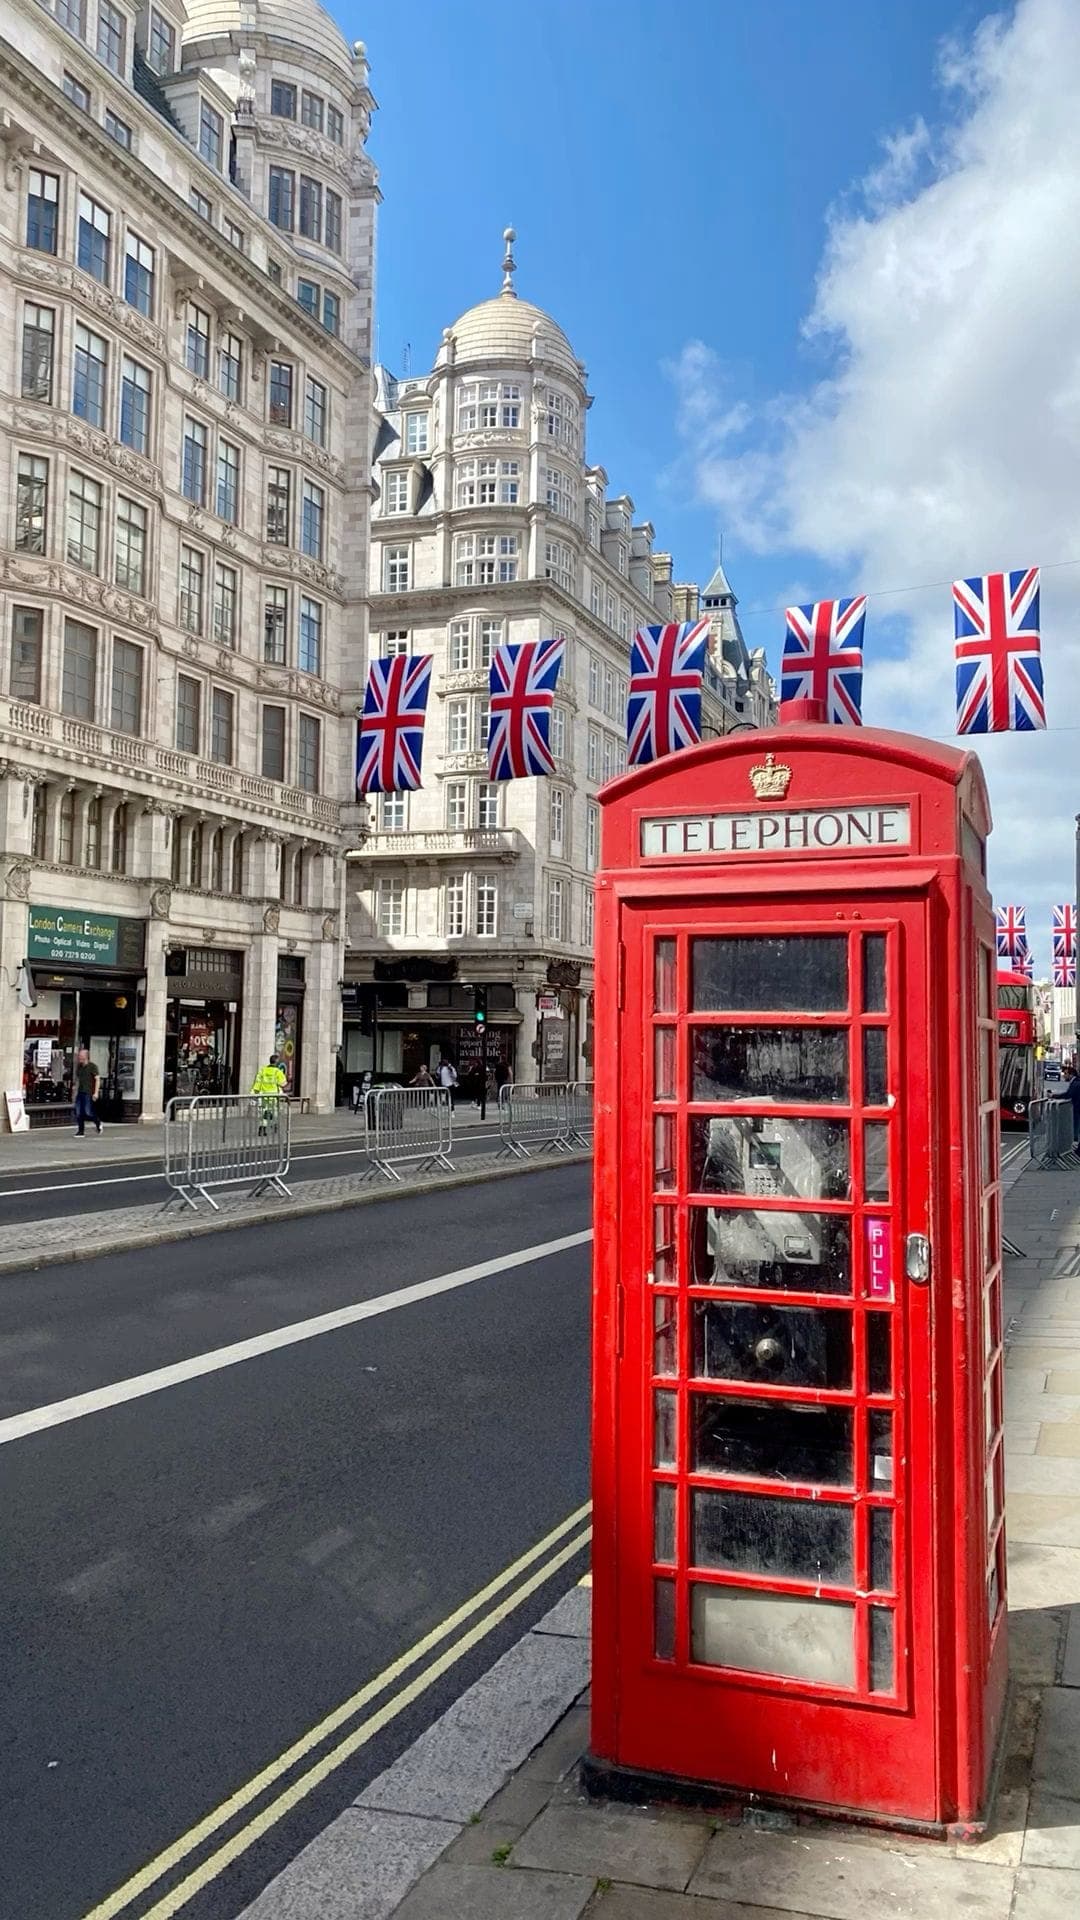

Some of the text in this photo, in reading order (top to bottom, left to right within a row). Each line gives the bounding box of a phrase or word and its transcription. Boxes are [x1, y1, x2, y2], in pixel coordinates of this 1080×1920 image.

[652, 810, 898, 853] TELEPHONE
[30, 912, 115, 940] London Camera Exchange
[34, 934, 109, 951] Photo Optical Video Digital
[51, 949, 64, 958] 020
[1000, 1023, 1015, 1035] 87
[460, 1040, 501, 1049] opportnity
[460, 1046, 501, 1057] availble
[872, 1228, 883, 1290] PULL
